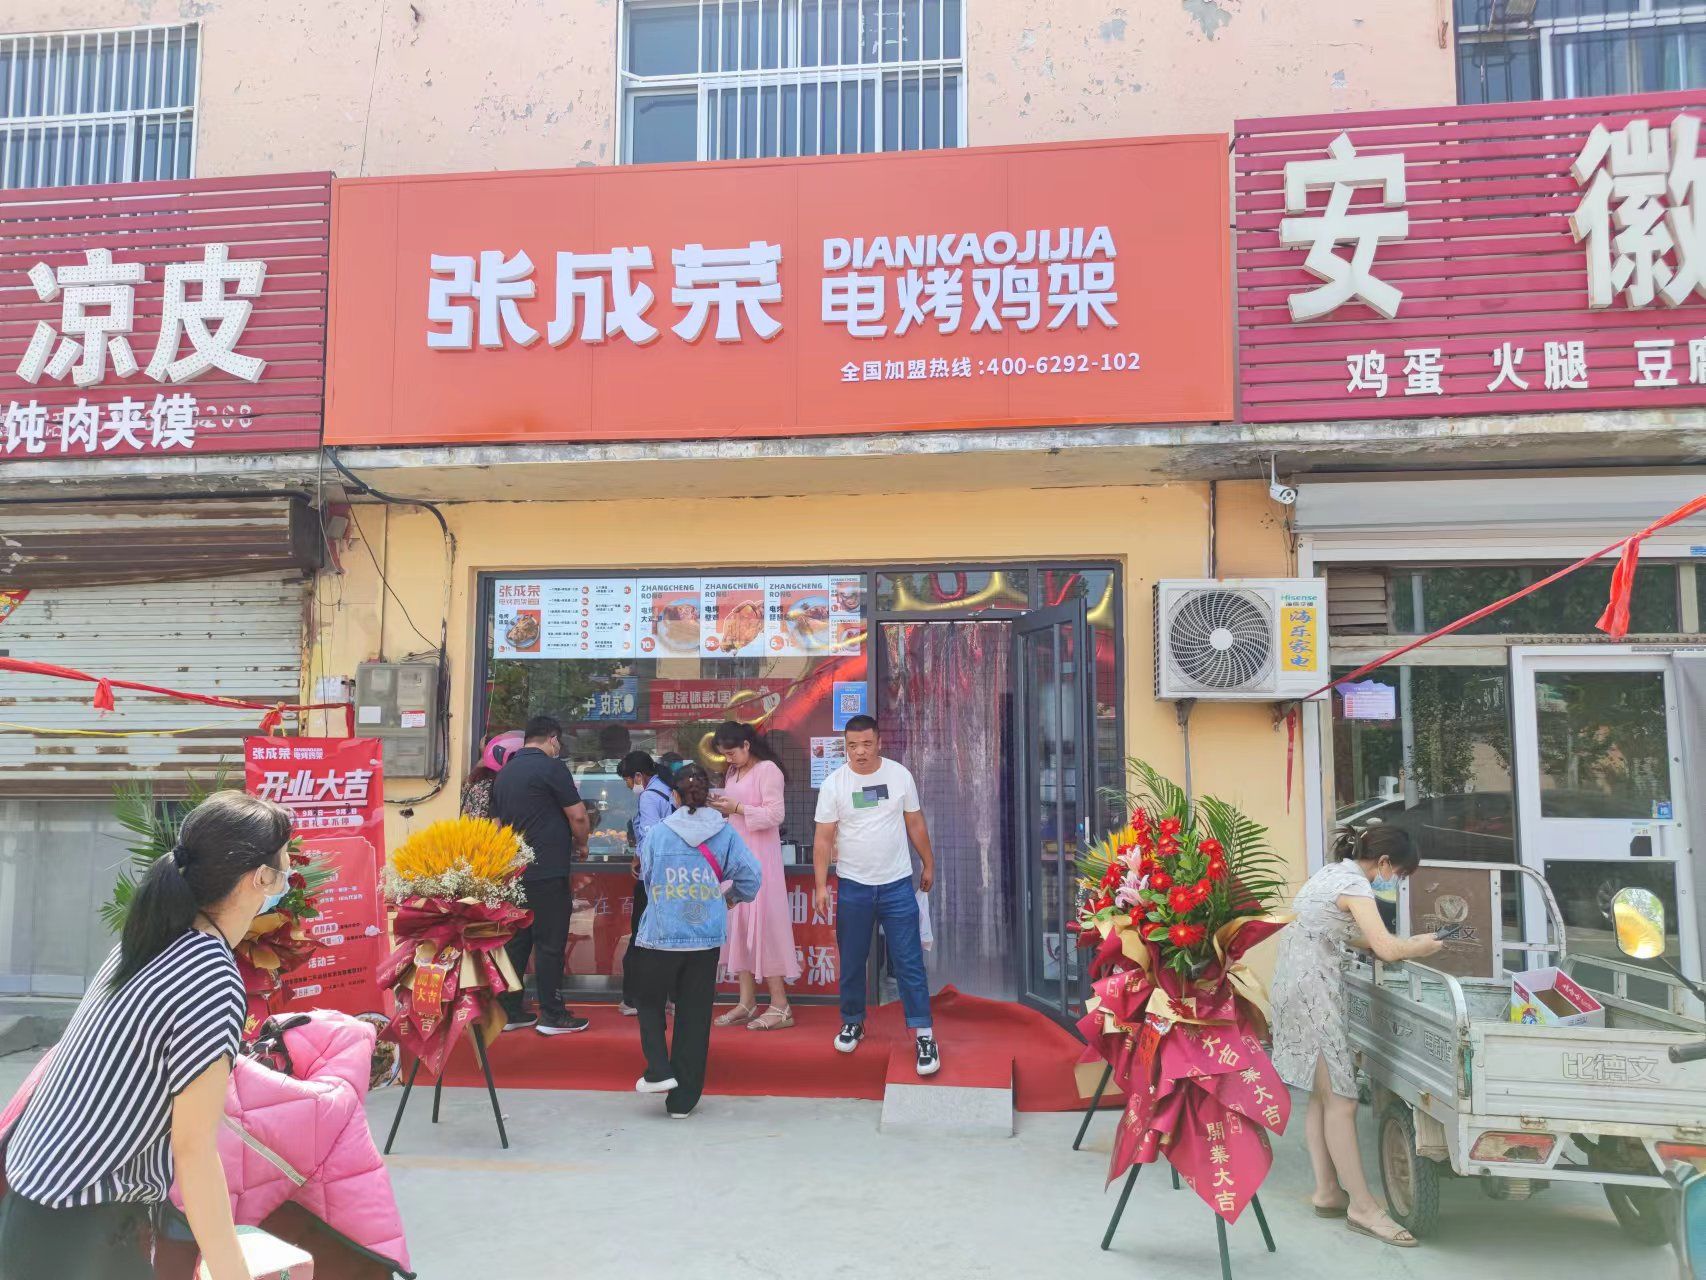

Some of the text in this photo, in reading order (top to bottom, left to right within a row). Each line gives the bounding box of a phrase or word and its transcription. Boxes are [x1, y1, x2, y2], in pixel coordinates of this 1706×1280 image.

[823, 225, 1117, 270] DIANKAOJIJIA
[16, 243, 268, 387] 凉皮
[427, 240, 784, 350] 张成荣
[821, 262, 1120, 339] 电烤鸡架
[1346, 350, 1444, 397] 鸡蛋
[1486, 341, 1589, 390] 火腿
[0, 392, 196, 454] 饨肉夹馍
[500, 585, 540, 597] 张成荣
[252, 747, 290, 760] 张成荣
[257, 768, 373, 802] 开业大吉
[308, 955, 336, 969] 活动三
[1201, 1034, 1241, 1068] 大吉
[1561, 1051, 1661, 1084] 比德文
[1205, 1120, 1237, 1213] 開業大吉
